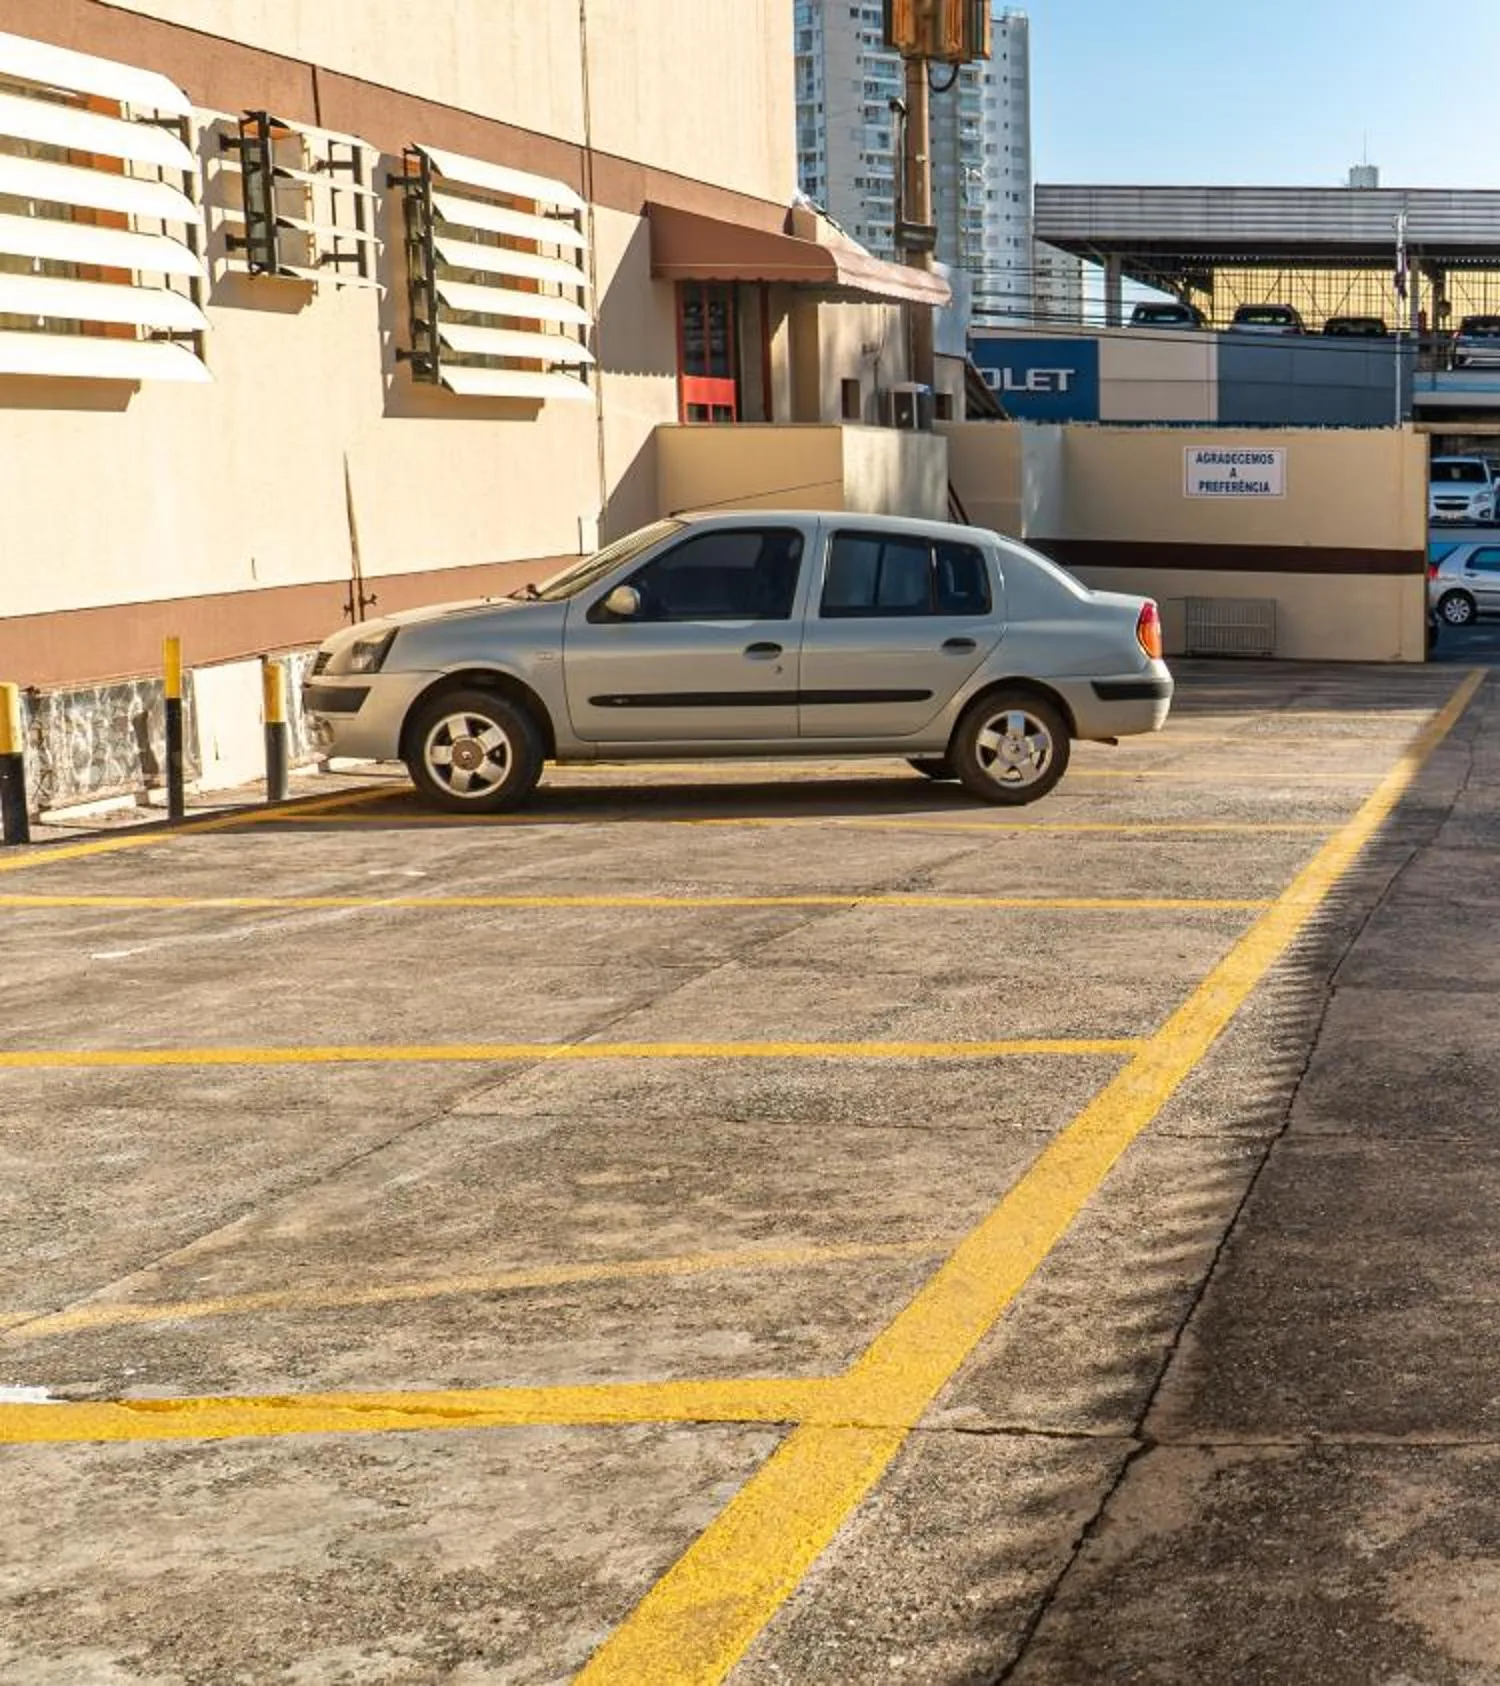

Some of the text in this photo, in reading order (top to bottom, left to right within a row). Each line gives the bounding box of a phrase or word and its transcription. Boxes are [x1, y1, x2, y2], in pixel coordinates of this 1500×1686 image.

[1195, 452, 1275, 465] AGRADECEMOS
[1229, 467, 1238, 478] A
[1199, 480, 1271, 493] PREFERÊNCIA
